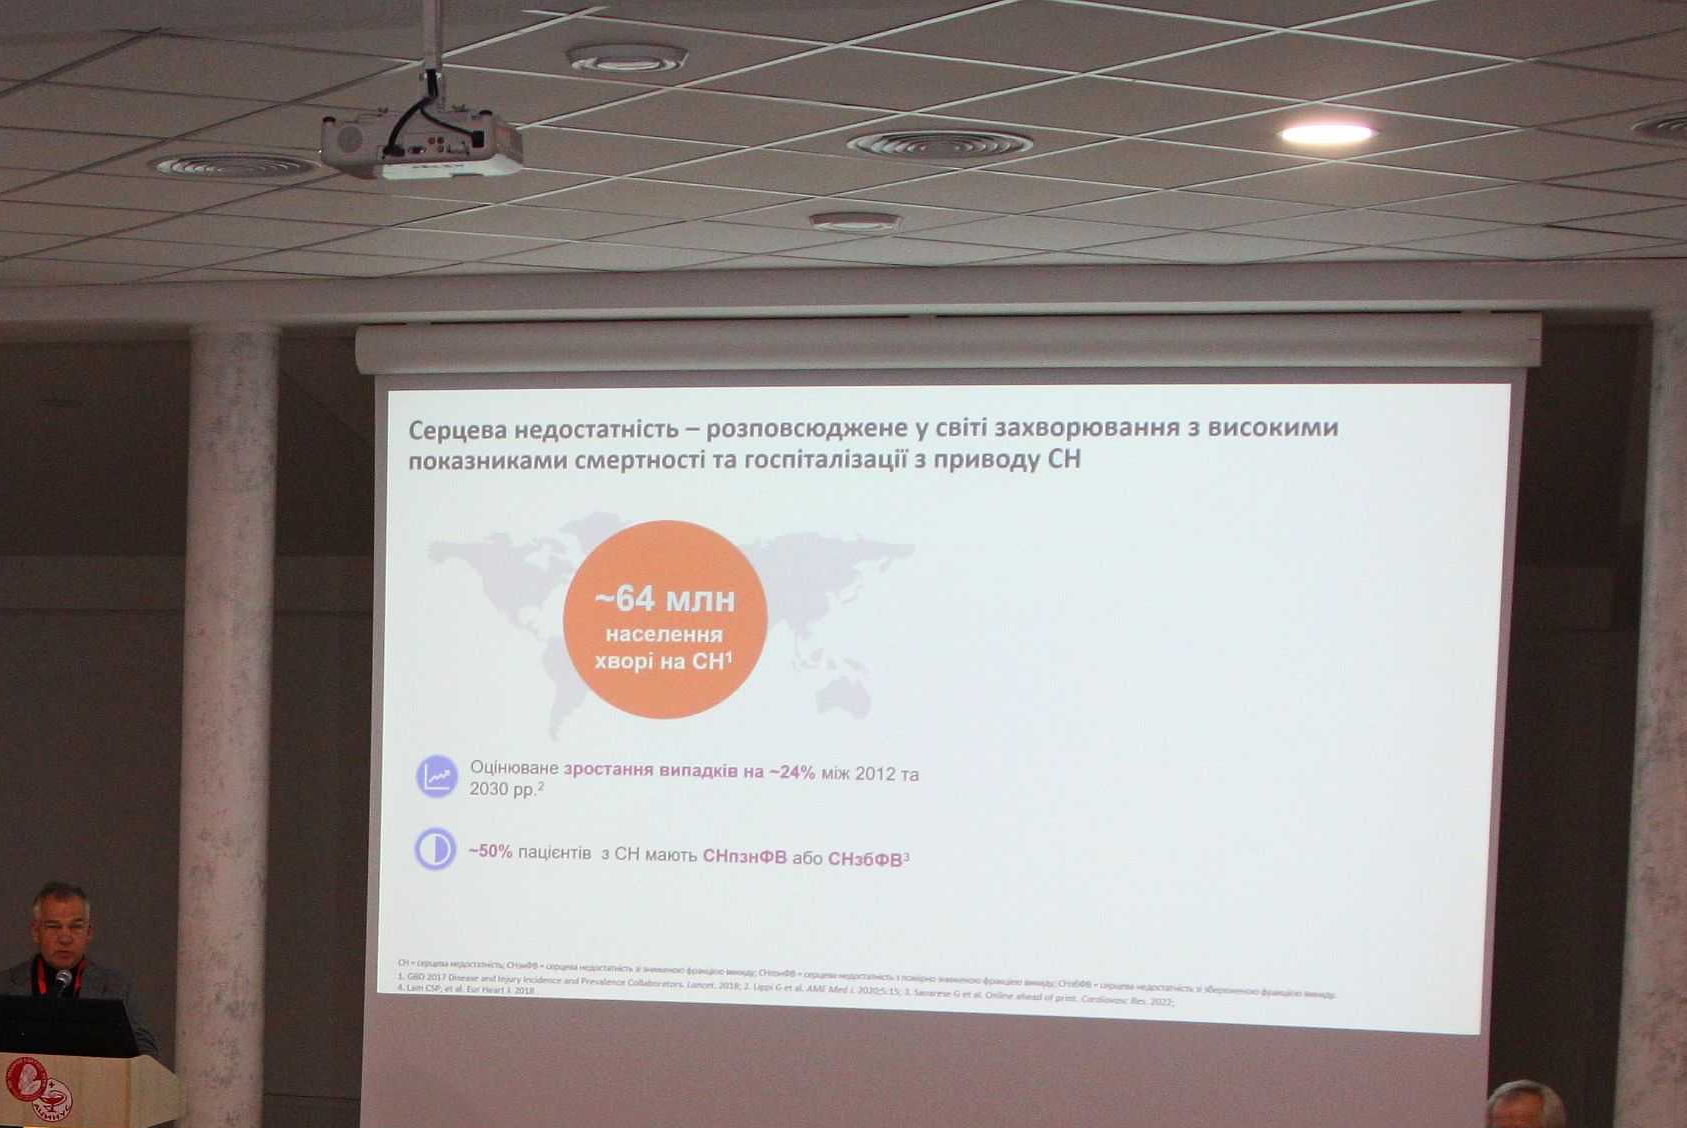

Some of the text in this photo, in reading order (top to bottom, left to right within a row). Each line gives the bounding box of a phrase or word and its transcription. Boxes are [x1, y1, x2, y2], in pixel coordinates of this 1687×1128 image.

[409, 420, 507, 443] Серцева
[515, 419, 679, 442] недостатність
[707, 421, 909, 442] розповсюджене
[916, 422, 929, 441] у
[936, 418, 987, 437] світі
[995, 420, 1180, 441] захворювання
[1188, 421, 1199, 437] з
[1208, 420, 1338, 437] високими
[409, 448, 1081, 473] показниками смертності та госпіталізації з приводу СН
[595, 583, 735, 612] ~64 млн
[606, 628, 723, 643] населення
[595, 651, 654, 674] хворі
[661, 655, 686, 670] на
[470, 759, 920, 782] Оцінюване зростання випадків на ~24% між 2012 та
[470, 781, 508, 796] 2030
[469, 843, 513, 859] ~50%
[519, 846, 592, 862] пацієнтів
[601, 848, 610, 860] з
[615, 846, 640, 861] СН
[645, 850, 698, 863] мають
[703, 848, 787, 864] СНпзнФВ
[793, 850, 823, 865] або
